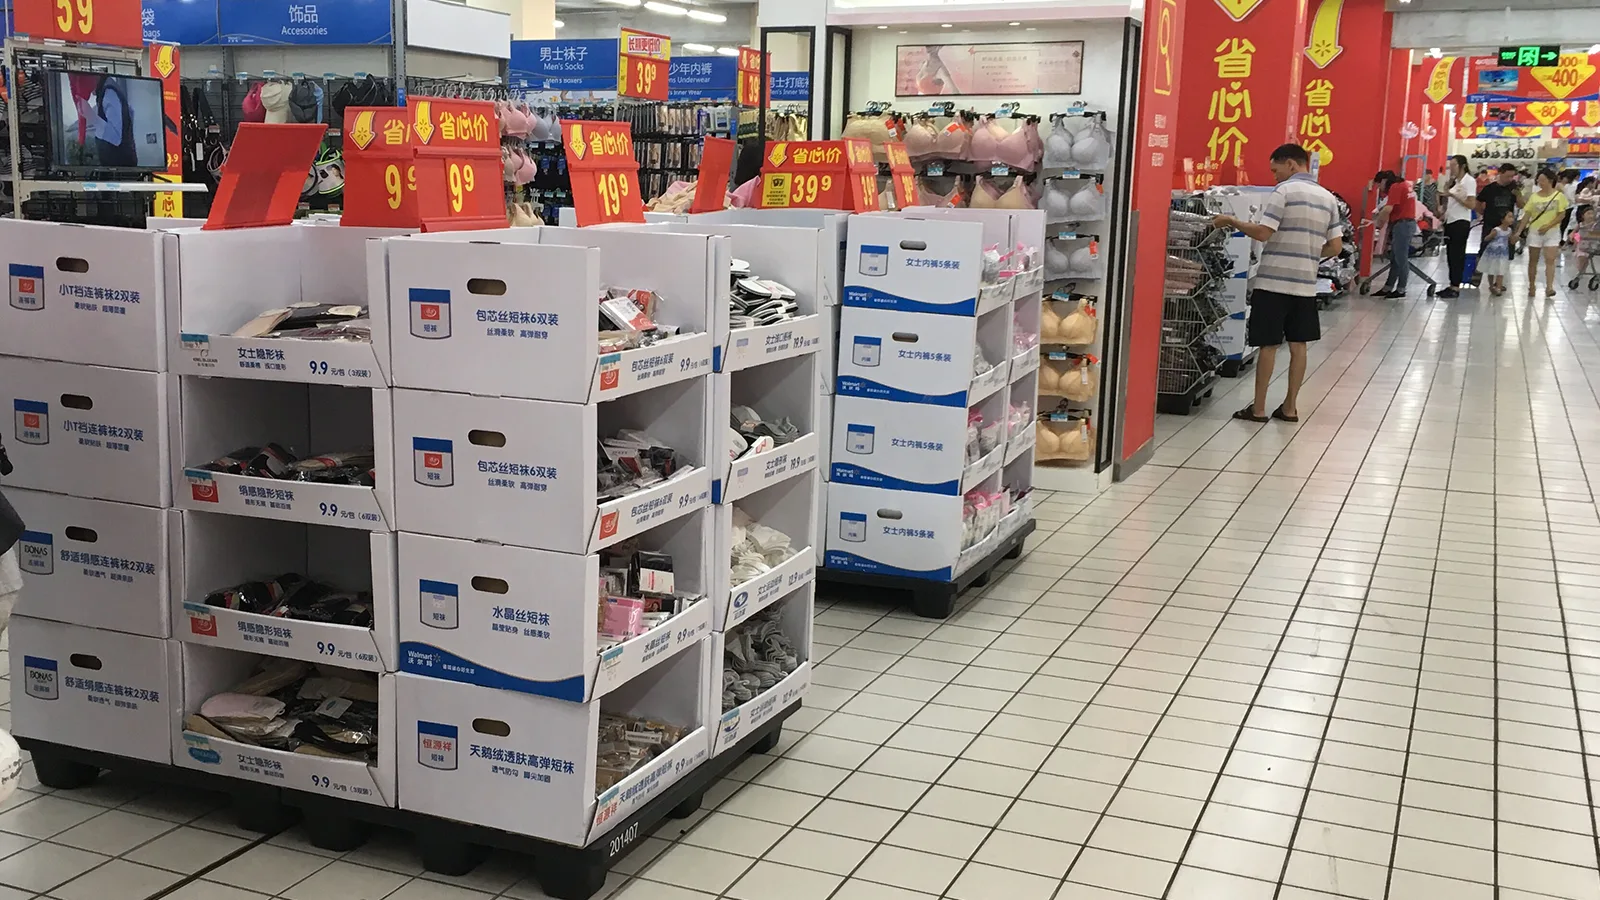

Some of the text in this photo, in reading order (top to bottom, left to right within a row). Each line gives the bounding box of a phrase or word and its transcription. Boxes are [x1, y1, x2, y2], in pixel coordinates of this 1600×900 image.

[288, 4, 319, 24] 饰品
[281, 25, 328, 36] Accessories
[540, 46, 588, 61] 男士袜子
[544, 62, 584, 71] Men's Socks
[1552, 69, 1578, 87] 400
[1207, 37, 1257, 167] 省心价
[1541, 105, 1557, 117] 80
[383, 119, 412, 145] 省
[439, 111, 489, 143] 省心价
[589, 130, 628, 156] 省心价
[792, 147, 842, 164] 省心价
[906, 258, 960, 270] 女士内裤5条装
[476, 309, 559, 326] 包芯丝短袜6双装
[423, 323, 438, 333] 短袜
[237, 347, 286, 360] 女士隐形袜
[898, 350, 952, 362] 女士内裤5条装
[309, 360, 328, 375] 9.9
[680, 357, 691, 373] 9.9
[891, 438, 944, 451] 女士内裤5条装
[427, 472, 441, 480] 短袜
[477, 459, 558, 480] 包芯丝短袜6双装
[319, 502, 338, 517] 9.9
[883, 526, 935, 539] 女士内裤5条装
[432, 612, 446, 621] 短袜
[492, 605, 550, 626] 水晶丝短袜
[317, 641, 335, 656] 9.9
[408, 650, 433, 660] Walmart
[408, 657, 433, 667] 沃尔玛
[423, 738, 452, 752] 恒源祥
[430, 753, 445, 763] 短袜
[469, 744, 575, 774] 天鹅绒透肤高弹短袜
[311, 775, 330, 788] 9.9
[609, 821, 639, 857] 201407
